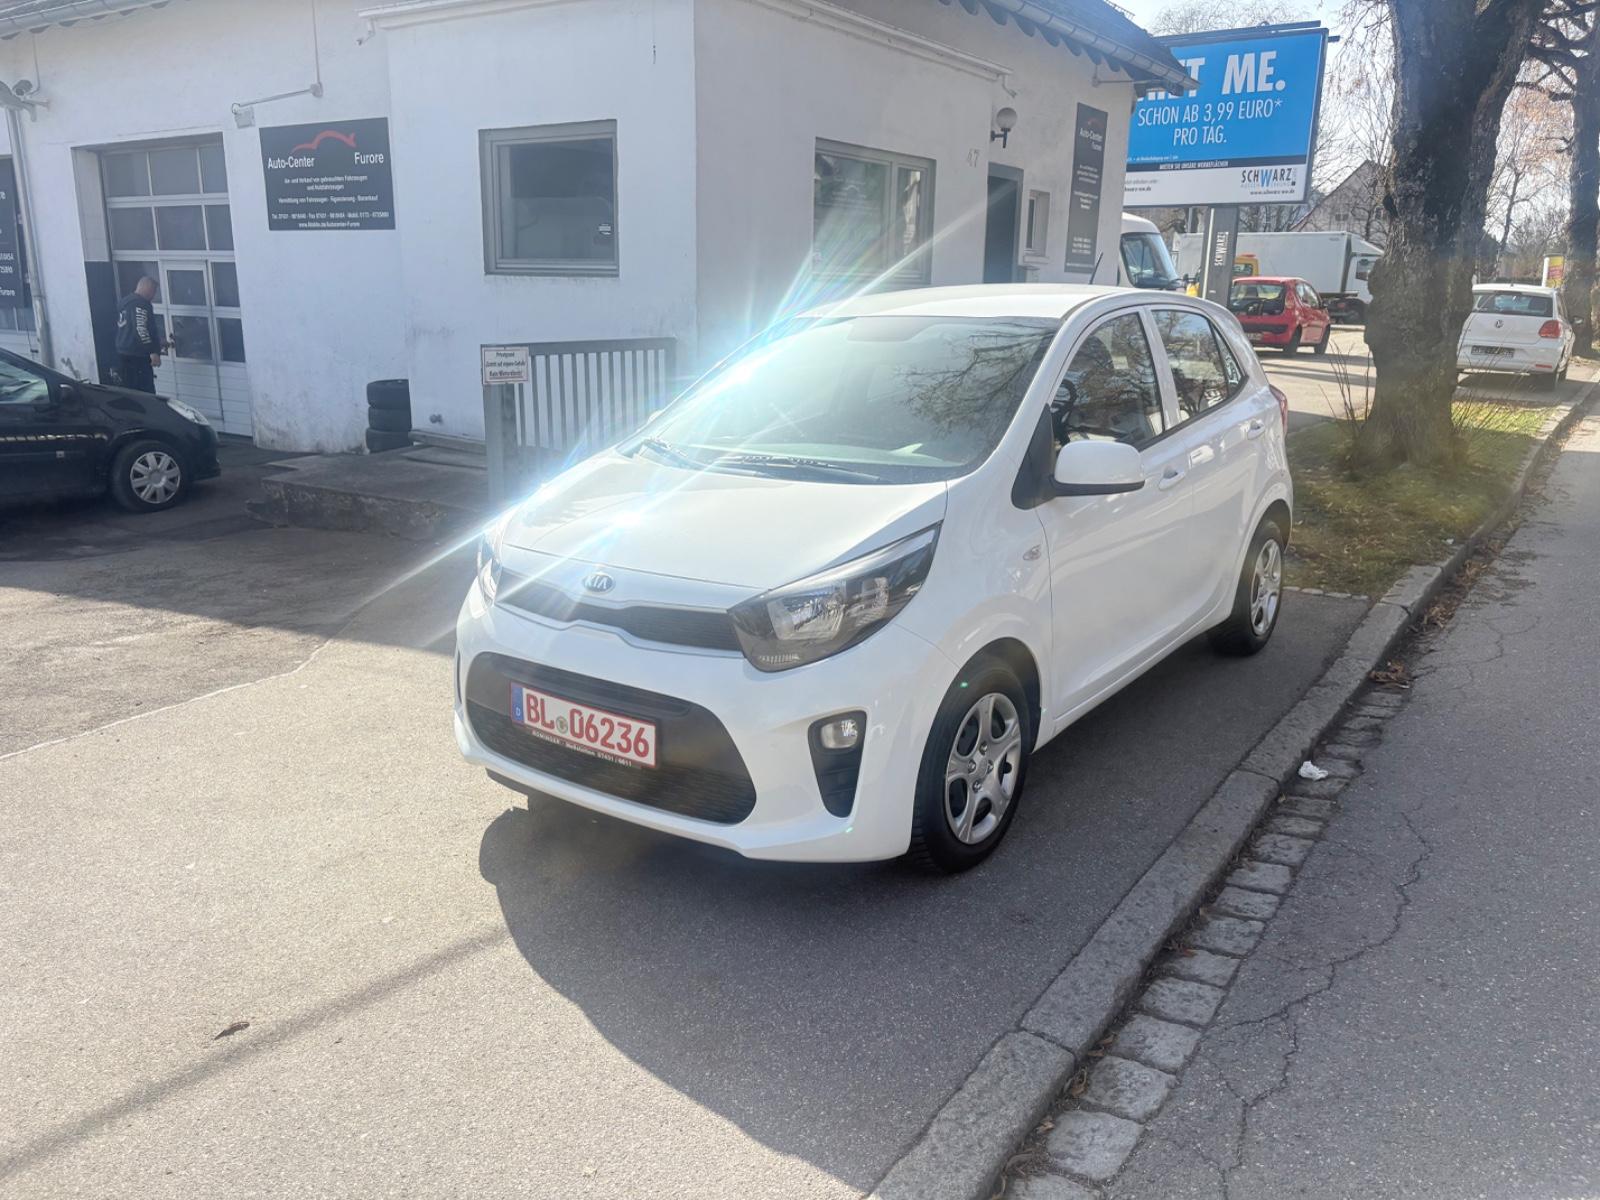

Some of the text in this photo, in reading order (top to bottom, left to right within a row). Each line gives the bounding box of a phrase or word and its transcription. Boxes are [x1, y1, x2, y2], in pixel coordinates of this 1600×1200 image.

[1221, 50, 1286, 96] ME.
[1137, 105, 1180, 127] SCHON
[1182, 103, 1199, 124] AB
[1203, 101, 1235, 125] 3,99
[1173, 125, 1227, 146] PRO TAG.
[267, 156, 315, 169] Auto-Center
[354, 152, 384, 165] Furore
[526, 693, 555, 730] BL
[569, 708, 650, 758] 06236
